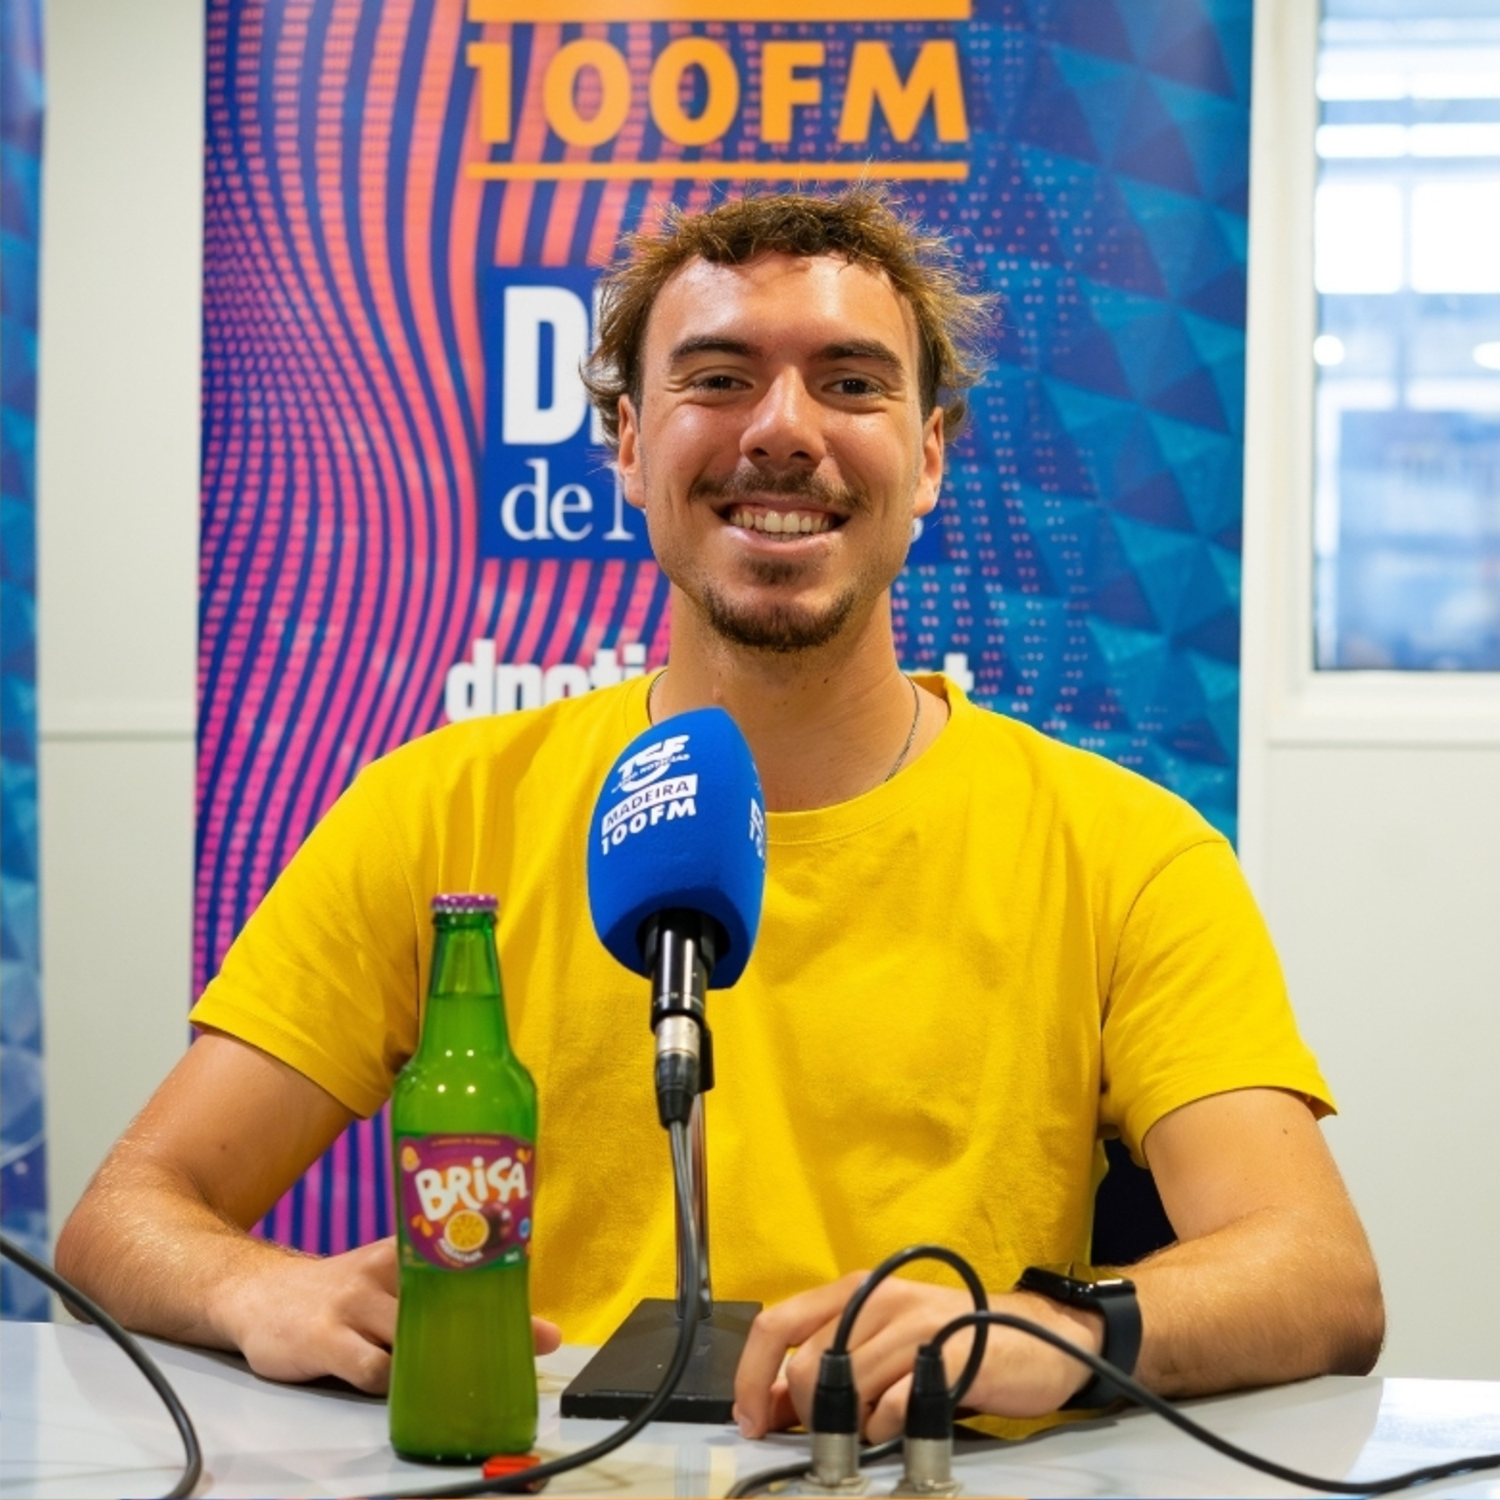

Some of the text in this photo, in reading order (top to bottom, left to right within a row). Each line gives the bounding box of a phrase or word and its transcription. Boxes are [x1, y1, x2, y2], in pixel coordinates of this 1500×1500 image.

[467, 37, 970, 147] 100FM
[501, 457, 594, 541] de
[601, 798, 697, 856] 100FM
[604, 780, 690, 829] MADEIRA
